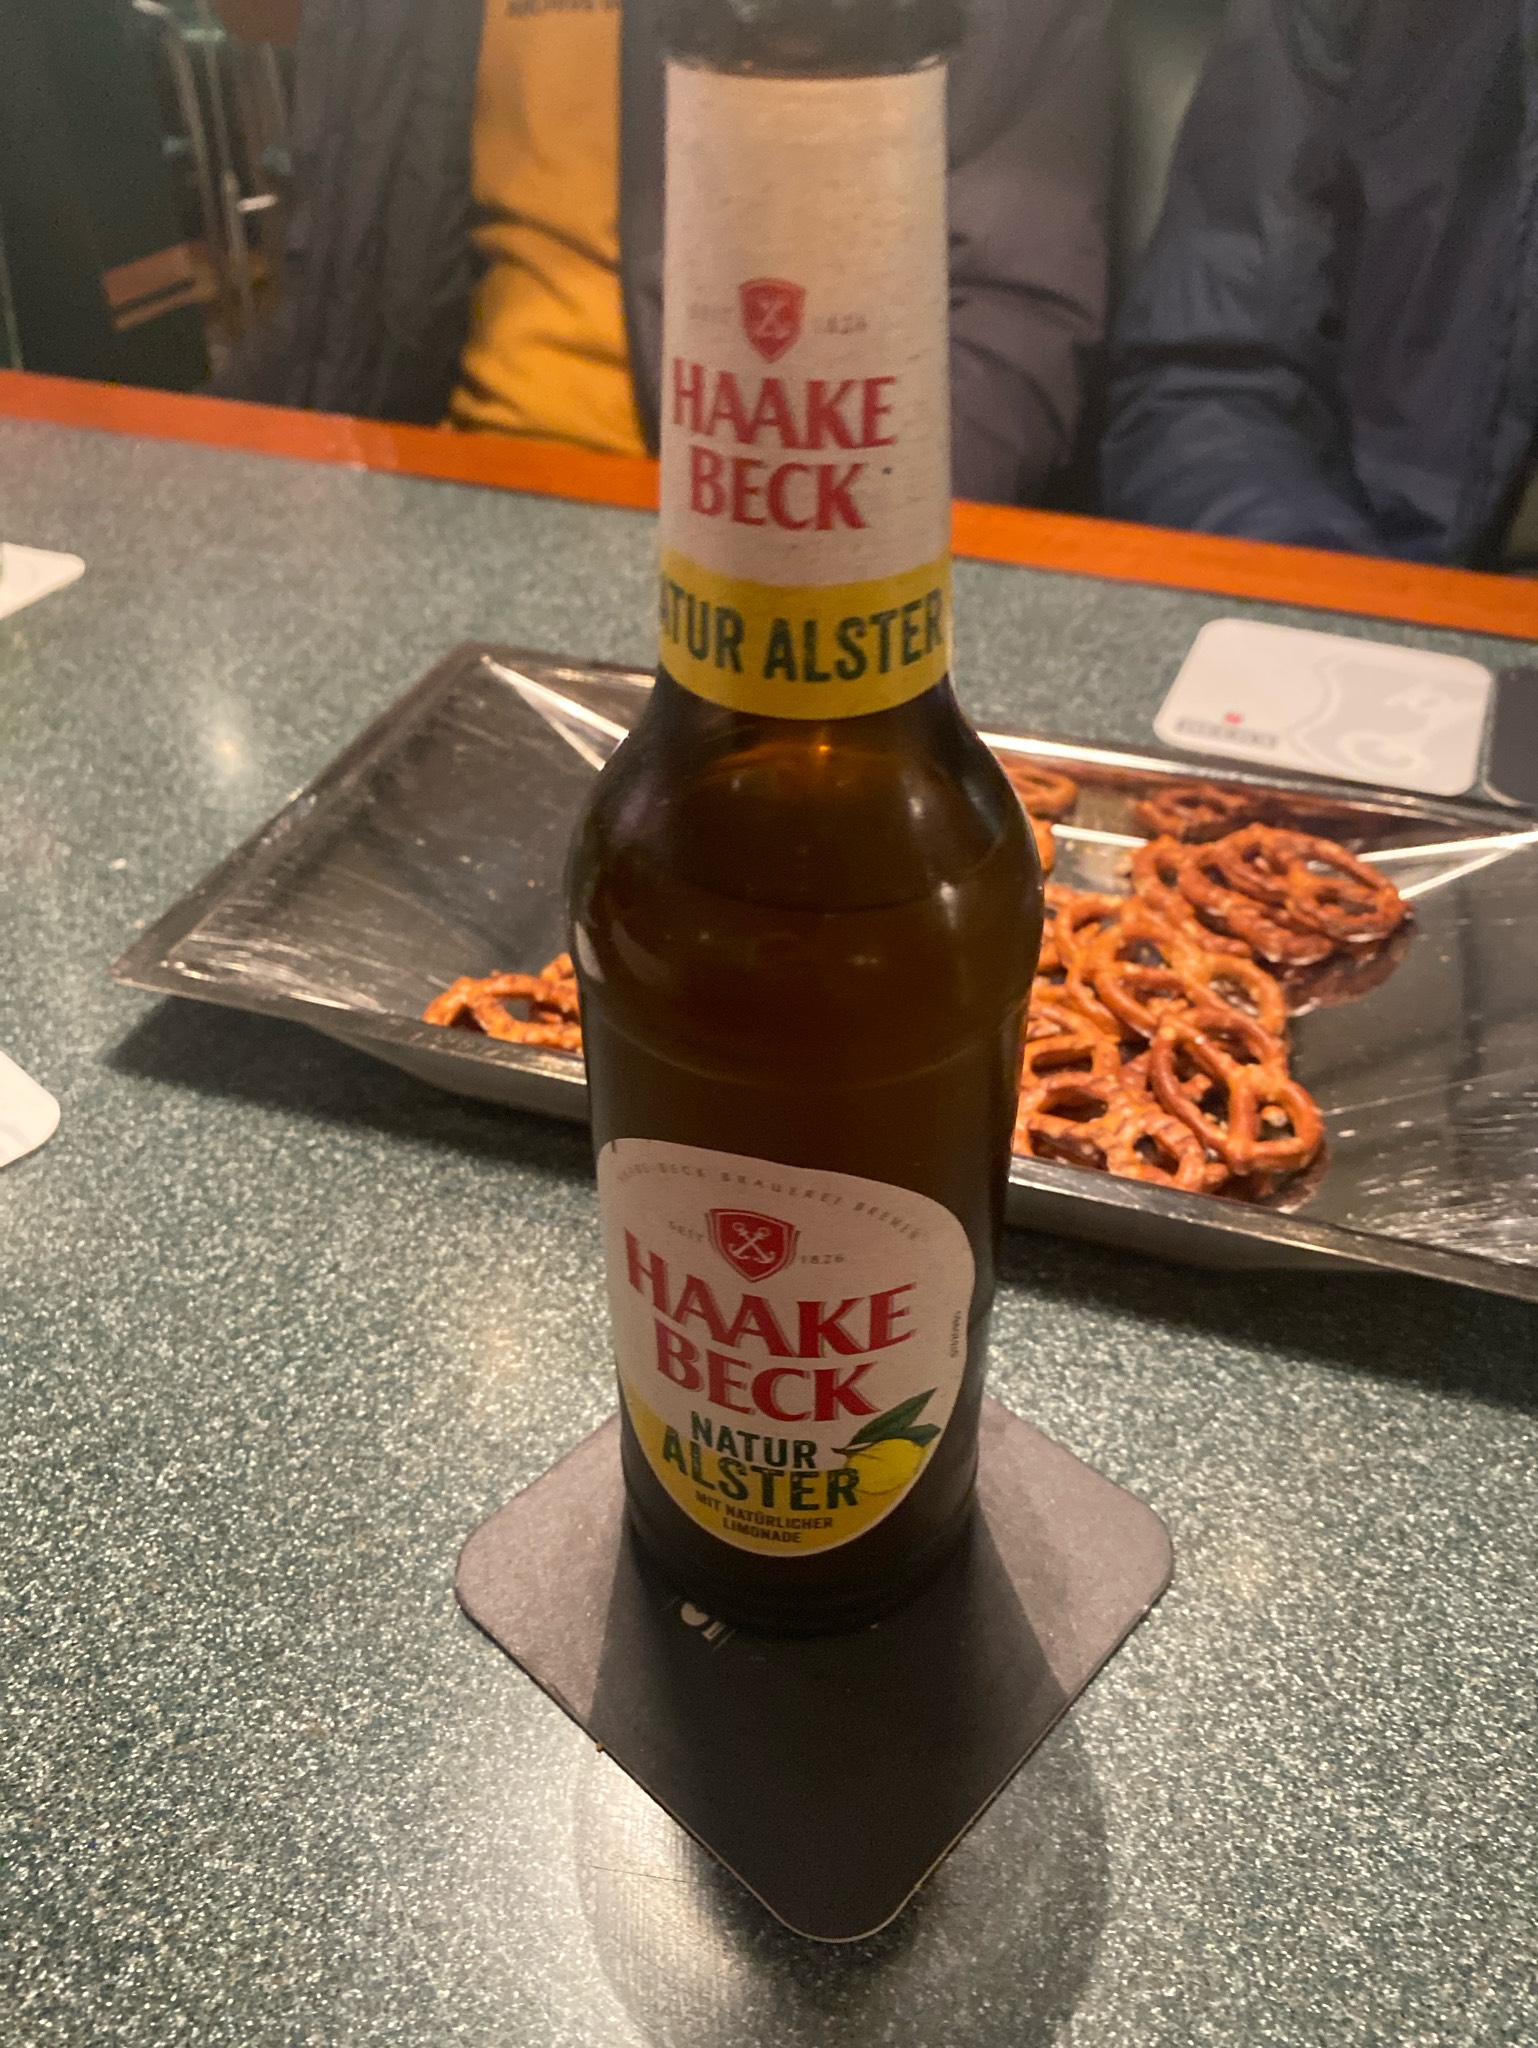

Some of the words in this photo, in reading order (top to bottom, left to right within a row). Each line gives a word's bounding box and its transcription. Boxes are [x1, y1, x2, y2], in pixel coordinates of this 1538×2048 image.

[672, 356, 898, 451] HAAKE
[689, 444, 869, 531] BECK
[763, 587, 943, 685] ALSTER
[625, 1227, 918, 1359] HAAKE
[801, 1252, 846, 1265] 1826
[654, 1316, 885, 1423] BECK
[662, 1424, 861, 1512] ALSTER
[691, 1410, 818, 1470] NATUR
[696, 1490, 723, 1512] MIT
[725, 1502, 834, 1531] NATÜRLICHER
[723, 1516, 803, 1544] LIMONADE
